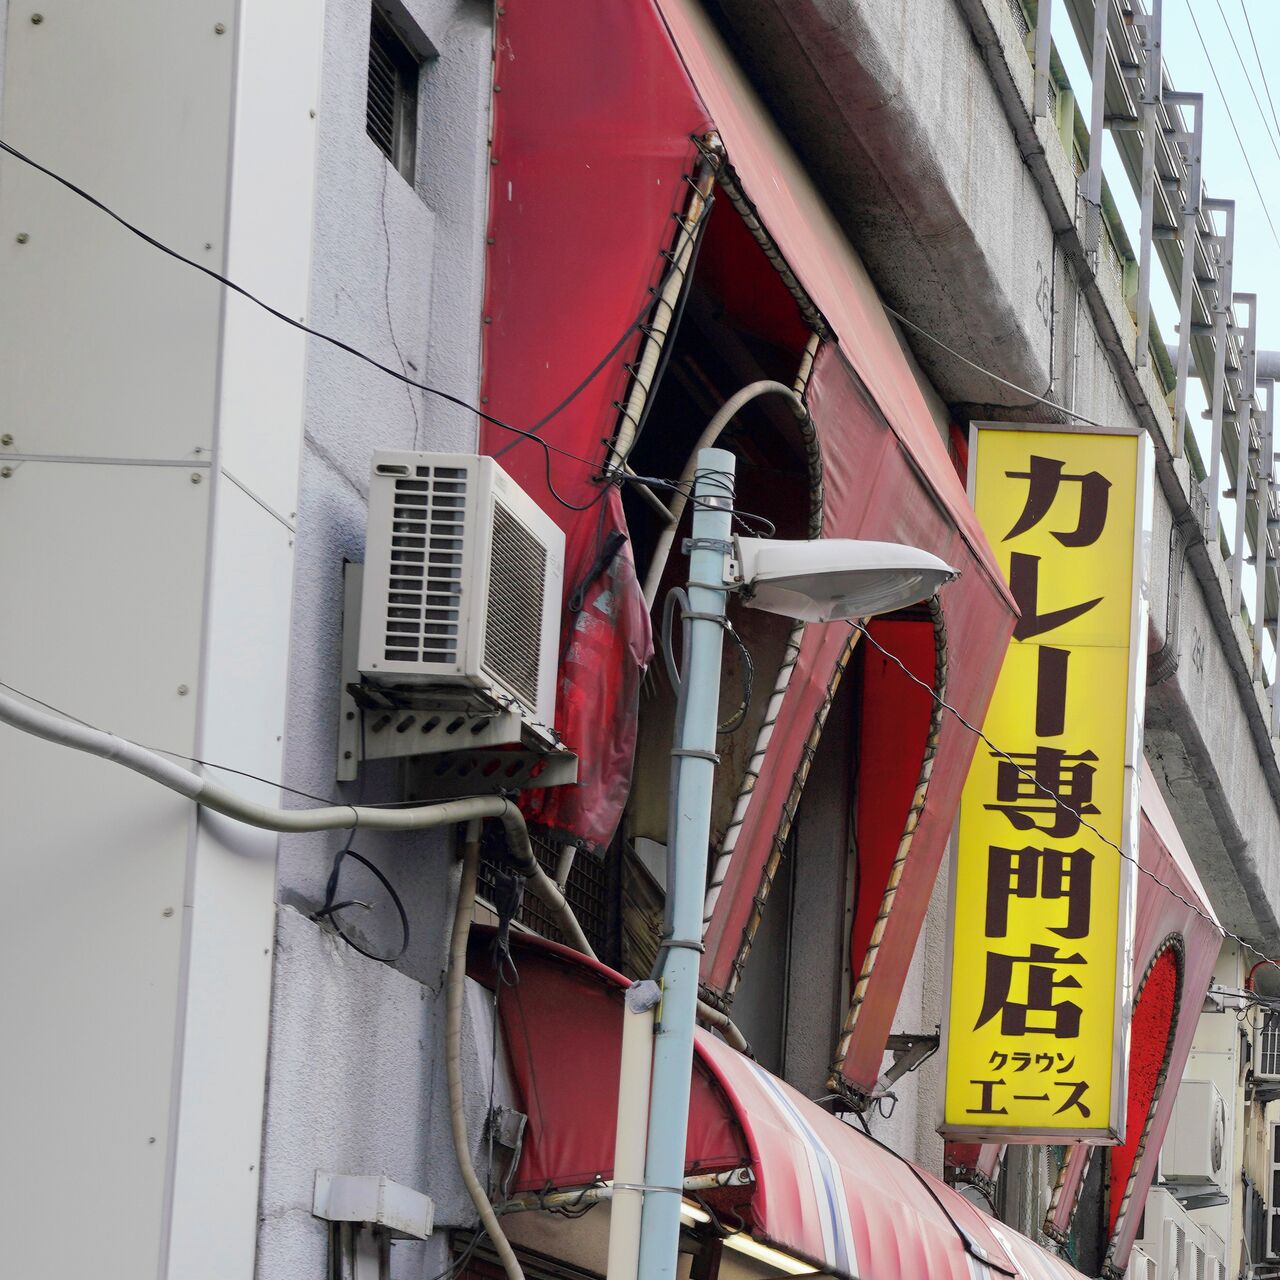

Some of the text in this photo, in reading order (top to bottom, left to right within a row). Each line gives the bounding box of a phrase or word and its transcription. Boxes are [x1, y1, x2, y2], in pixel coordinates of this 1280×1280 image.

[973, 455, 1114, 1042] カレー専門店
[988, 1049, 1077, 1076] クラウン
[965, 1079, 1092, 1120] エース
